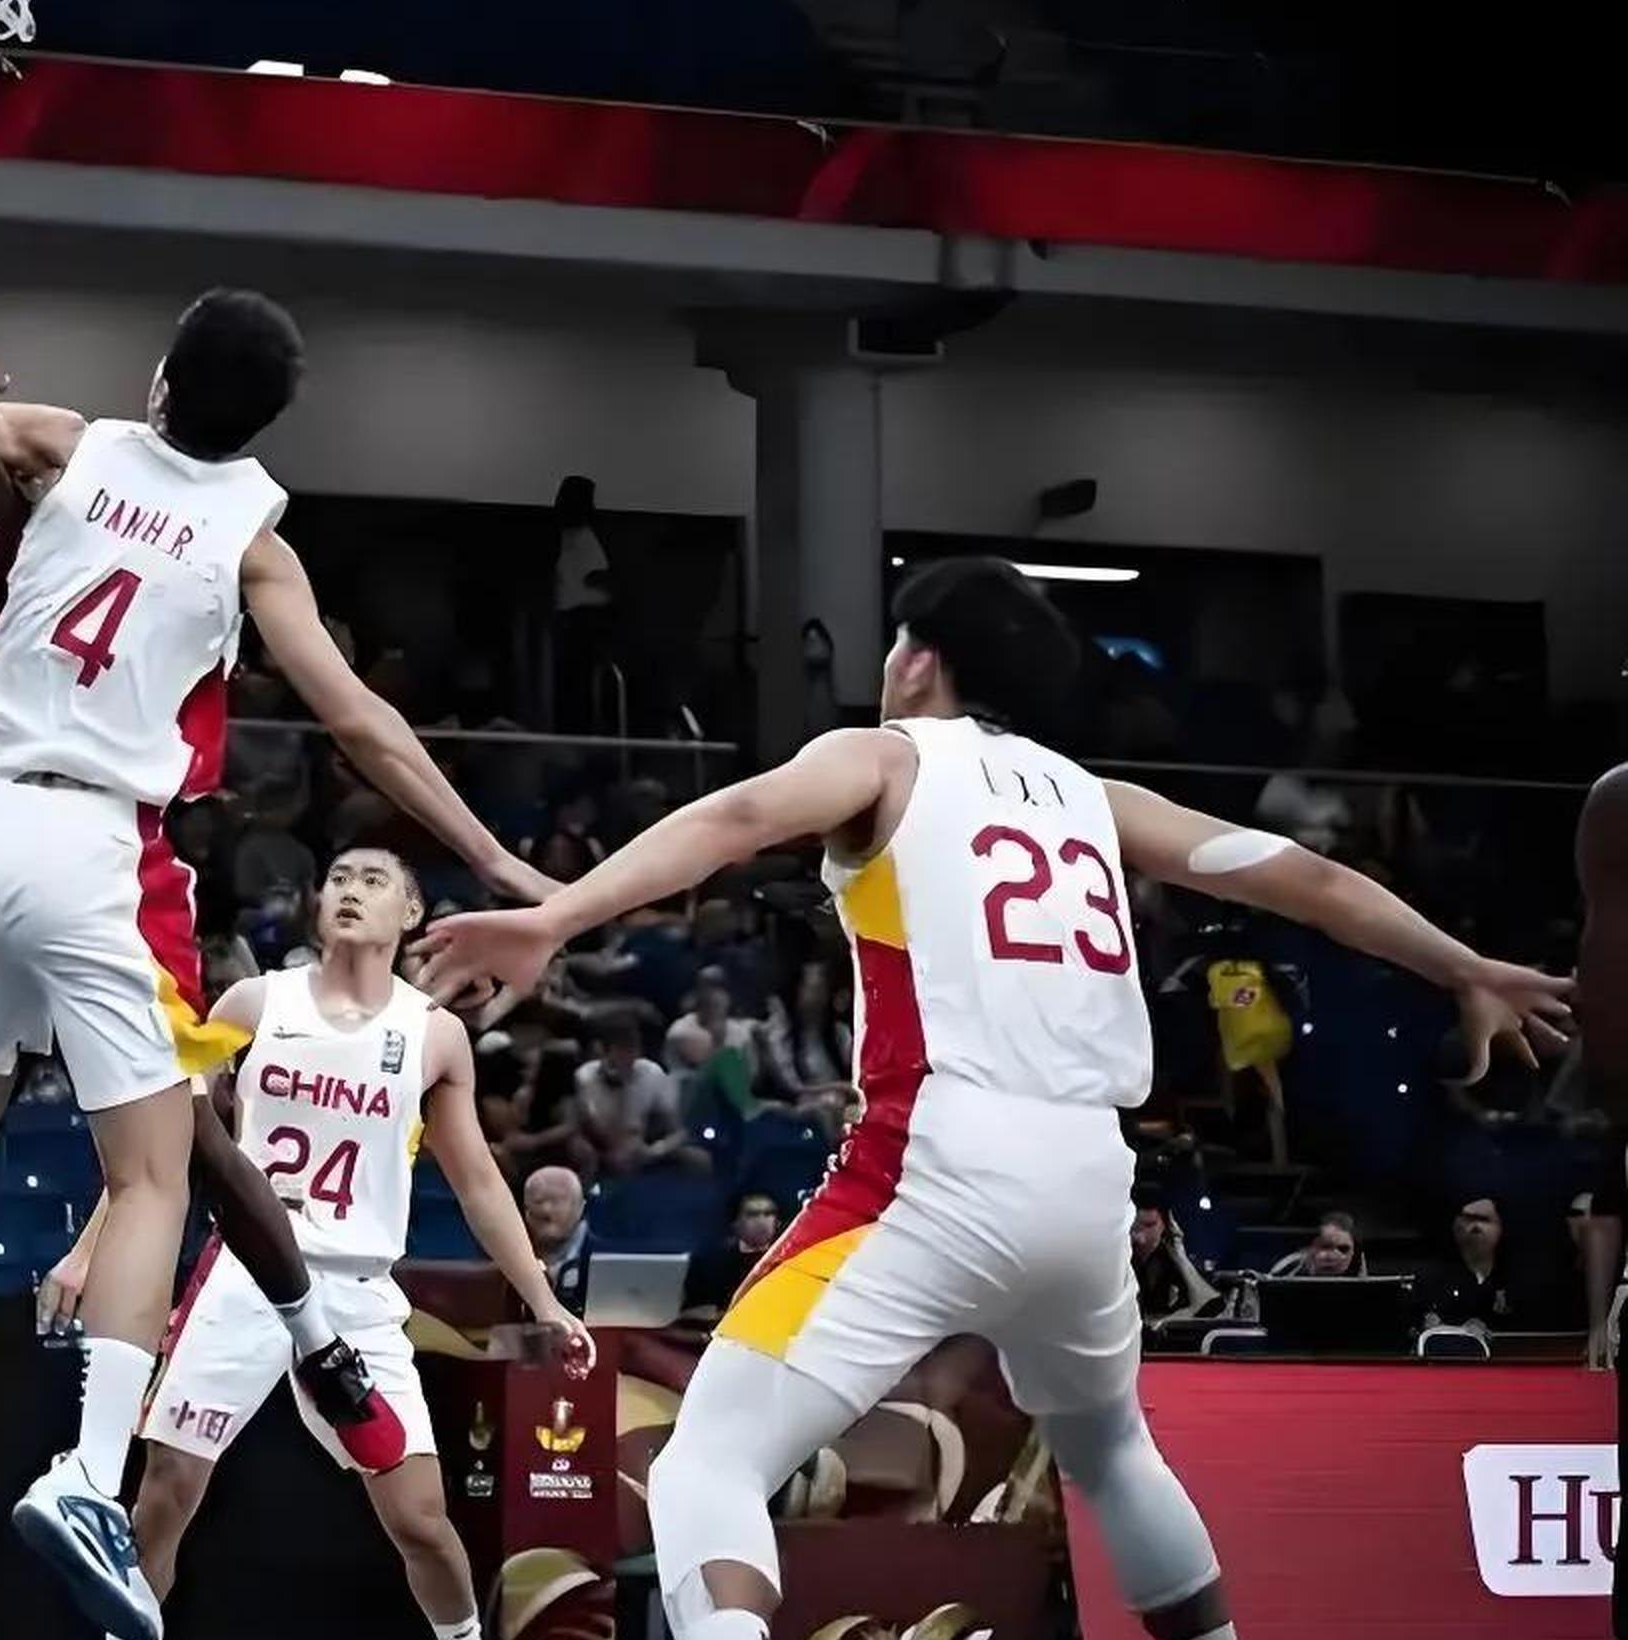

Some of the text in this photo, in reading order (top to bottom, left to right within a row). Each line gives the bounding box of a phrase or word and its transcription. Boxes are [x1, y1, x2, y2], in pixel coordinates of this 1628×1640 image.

[50, 567, 142, 689] 4
[970, 824, 1131, 975] 23
[259, 1063, 390, 1118] CHINA
[264, 1126, 360, 1220] 24
